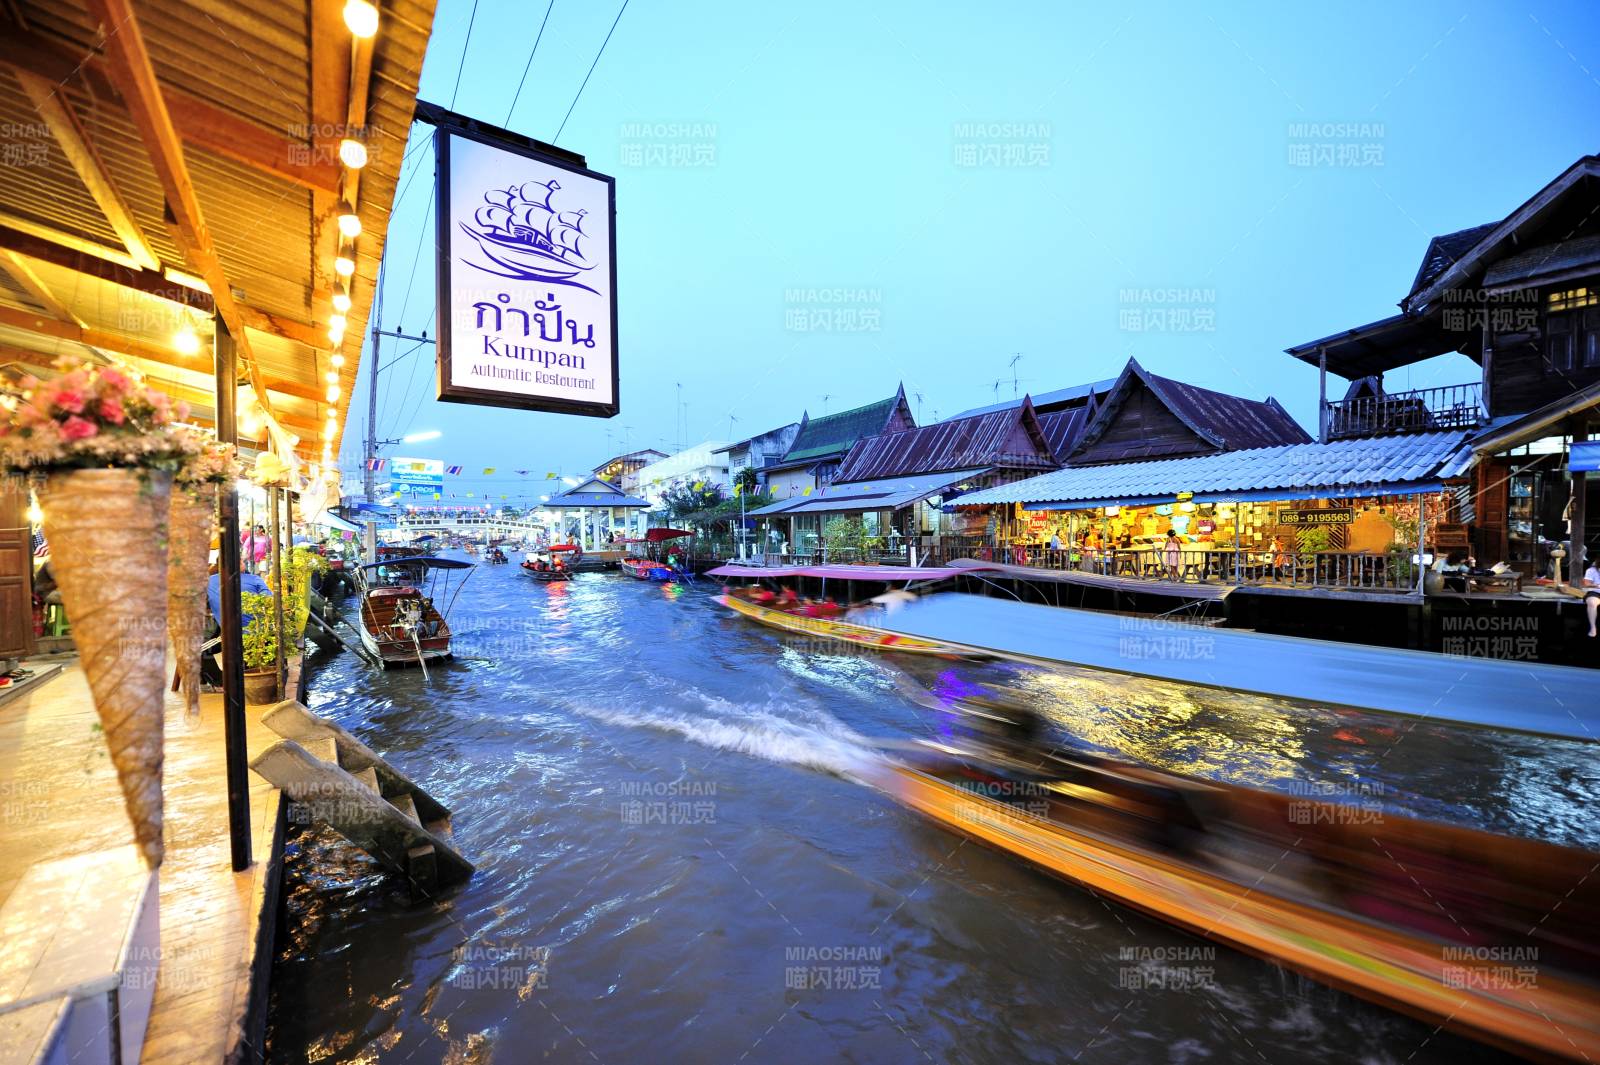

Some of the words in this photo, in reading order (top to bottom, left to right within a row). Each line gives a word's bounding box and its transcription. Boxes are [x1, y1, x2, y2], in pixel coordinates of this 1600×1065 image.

[472, 292, 596, 349] กำปั่น
[482, 335, 586, 369] Kumpan
[470, 364, 531, 382] Authentic
[411, 485, 436, 495] pepsi
